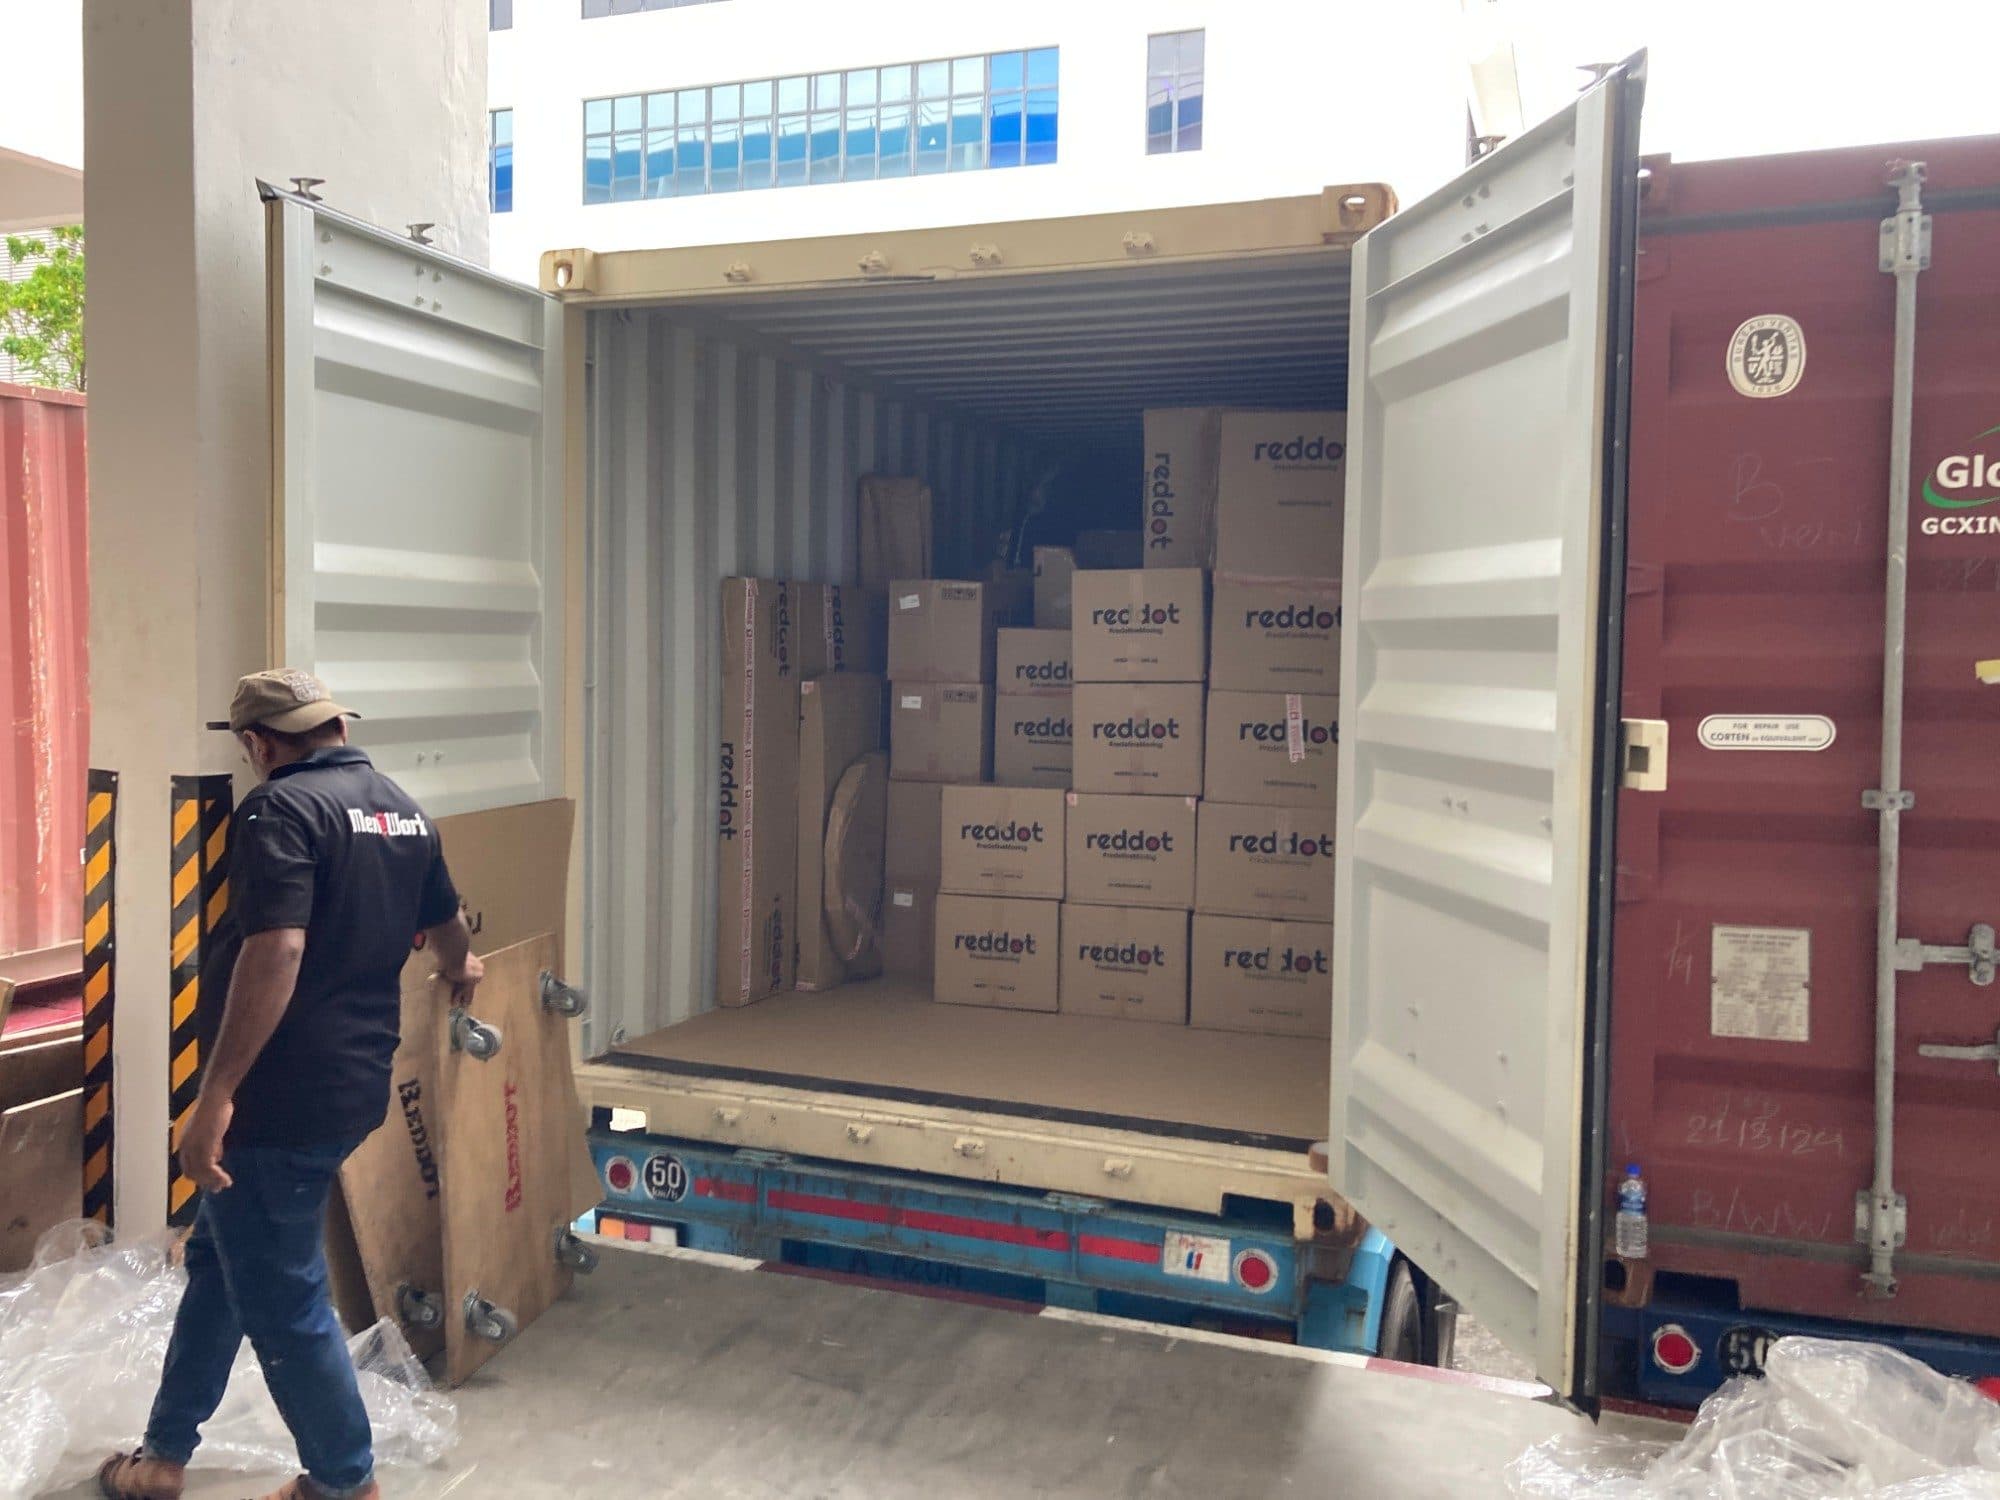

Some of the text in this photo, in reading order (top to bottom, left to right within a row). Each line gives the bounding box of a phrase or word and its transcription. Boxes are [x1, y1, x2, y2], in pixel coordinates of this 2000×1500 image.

[1254, 436, 1347, 462] reddo
[1151, 453, 1175, 548] reddot
[1016, 661, 1073, 680] redd
[1093, 718, 1179, 739] reddot
[1240, 719, 1339, 744] redot
[1754, 722, 1779, 730] REPAIR
[1710, 732, 1749, 742] CORTEN
[720, 743, 739, 840] reddot
[961, 821, 1043, 842] reddot
[1087, 830, 1173, 851] reddot
[955, 932, 1036, 954] reddot
[652, 1159, 681, 1188] 50
[652, 1186, 678, 1199] km/h
